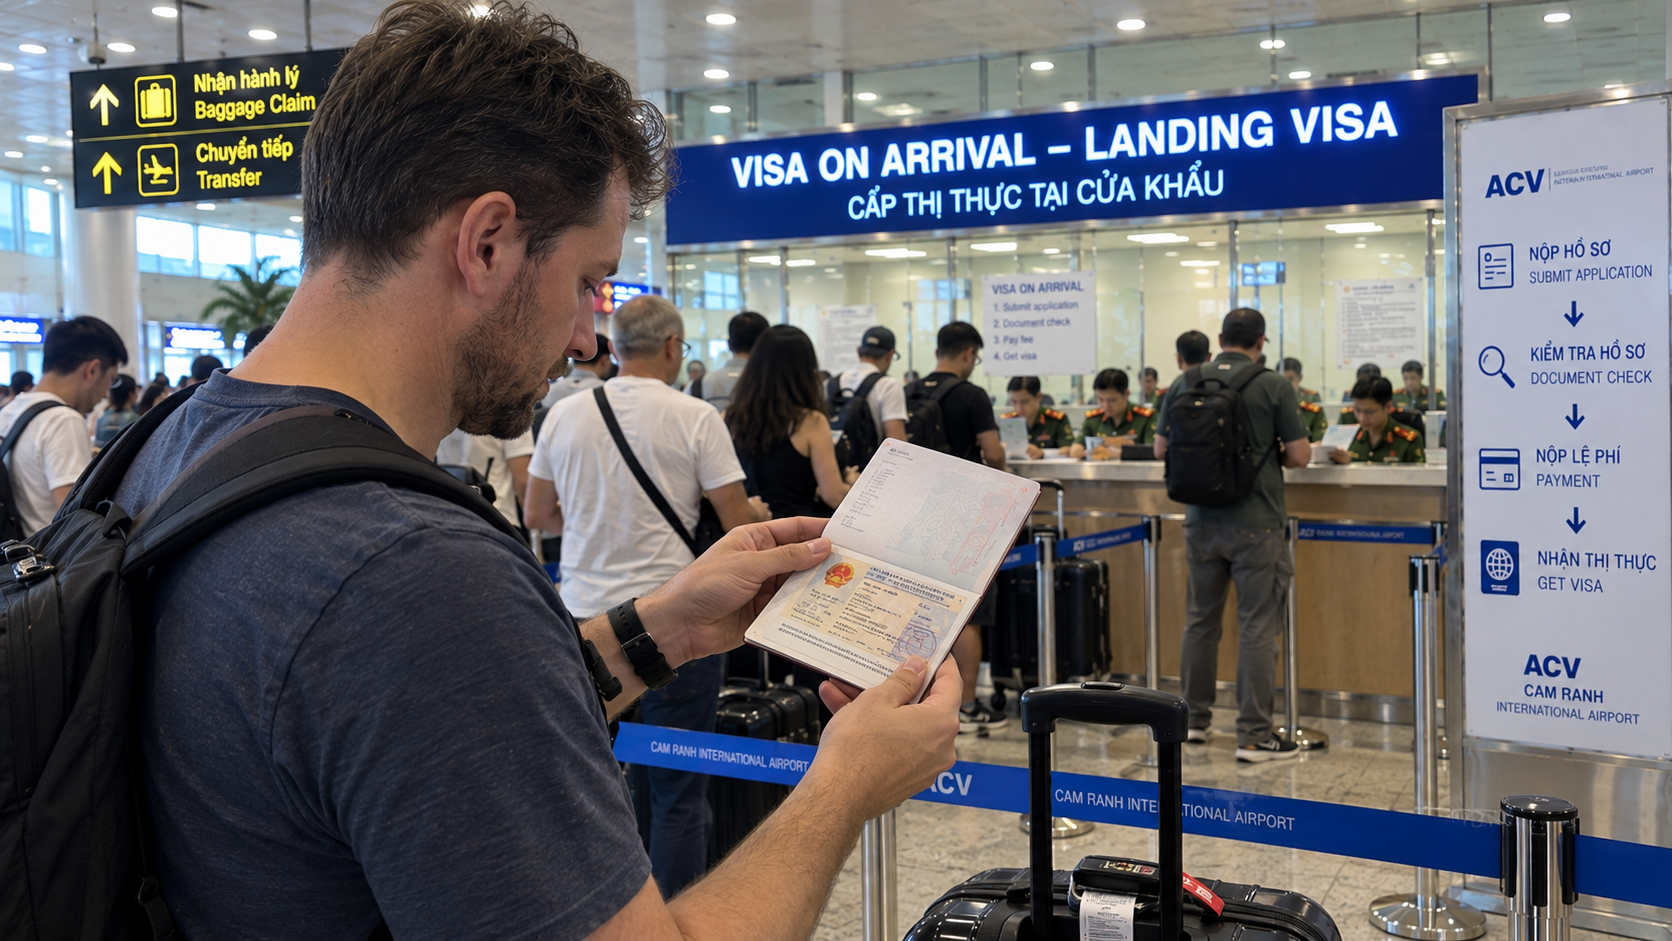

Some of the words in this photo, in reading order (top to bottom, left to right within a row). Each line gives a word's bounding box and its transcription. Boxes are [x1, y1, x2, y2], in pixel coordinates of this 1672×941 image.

[194, 72, 236, 95] Nhận
[240, 67, 280, 89] hành
[285, 65, 299, 89] lý
[195, 100, 265, 121] Baggage
[270, 92, 315, 113] Claim
[196, 136, 257, 165] Chuyển
[261, 134, 293, 161] tiếp
[732, 152, 808, 187] VISA
[819, 147, 868, 181] ON
[881, 133, 1036, 176] ARRIVAL
[1086, 111, 1273, 160] LANDING
[1291, 101, 1398, 143] VISA
[196, 167, 262, 190] Transfer
[849, 185, 896, 219] CẤP
[903, 191, 941, 218] THỊ
[950, 182, 1021, 215] THỰC
[1029, 182, 1067, 211] TẠI
[1077, 170, 1135, 204] CỬA
[1145, 160, 1223, 200] KHẨU
[1486, 169, 1544, 198] ACV
[1530, 242, 1559, 263] NỘP
[1565, 237, 1585, 258] HỒ
[1591, 239, 1611, 256] SƠ
[1530, 269, 1572, 284] SUBMIT
[1576, 265, 1652, 281] APPLICATION
[992, 284, 1016, 294] VISA
[1019, 283, 1035, 294] ON
[1038, 281, 1083, 292] ARRIVAL
[993, 303, 1001, 312] 1.
[1003, 302, 1031, 312] Submit
[1034, 301, 1079, 312] application
[993, 319, 1001, 328] 2.
[1003, 319, 1044, 328] Document
[1047, 318, 1070, 326] check
[993, 335, 1001, 344] 3.
[1003, 335, 1018, 346] Pay
[1021, 335, 1033, 343] fee
[1531, 341, 1563, 361] KIỂM
[1569, 346, 1595, 361] TRA
[1601, 339, 1620, 359] HỒ
[1626, 343, 1645, 359] SƠ
[993, 352, 1001, 360] 4.
[1003, 352, 1018, 360] Get
[1021, 352, 1037, 360] visa
[1531, 371, 1602, 384] DOCUMENT
[1607, 370, 1652, 383] CHECK
[1537, 445, 1567, 466] NỘP
[1573, 445, 1590, 466] LỆ
[1596, 446, 1620, 463] PHÍ
[1537, 474, 1600, 487] PAYMENT
[1538, 548, 1579, 569] NHẬN
[1585, 553, 1608, 571] THỊ
[1614, 554, 1656, 573] THỰC
[1538, 576, 1565, 590] GET
[1571, 578, 1603, 592] VISA
[1524, 654, 1581, 679] ACV
[1524, 684, 1556, 699] CAM
[1562, 687, 1603, 703] RANH
[1497, 702, 1584, 720] INTERNATIONAL
[1588, 710, 1640, 724] AIRPORT
[651, 741, 670, 753] CAM
[673, 744, 696, 757] RANH
[699, 748, 767, 767] INTERNATIONAL
[769, 757, 810, 772] AIRPORT
[1055, 789, 1083, 803] CAM
[1088, 793, 1123, 809] RANH
[1128, 798, 1231, 822] INTETIONAL
[1235, 811, 1295, 830] AIRPORT
